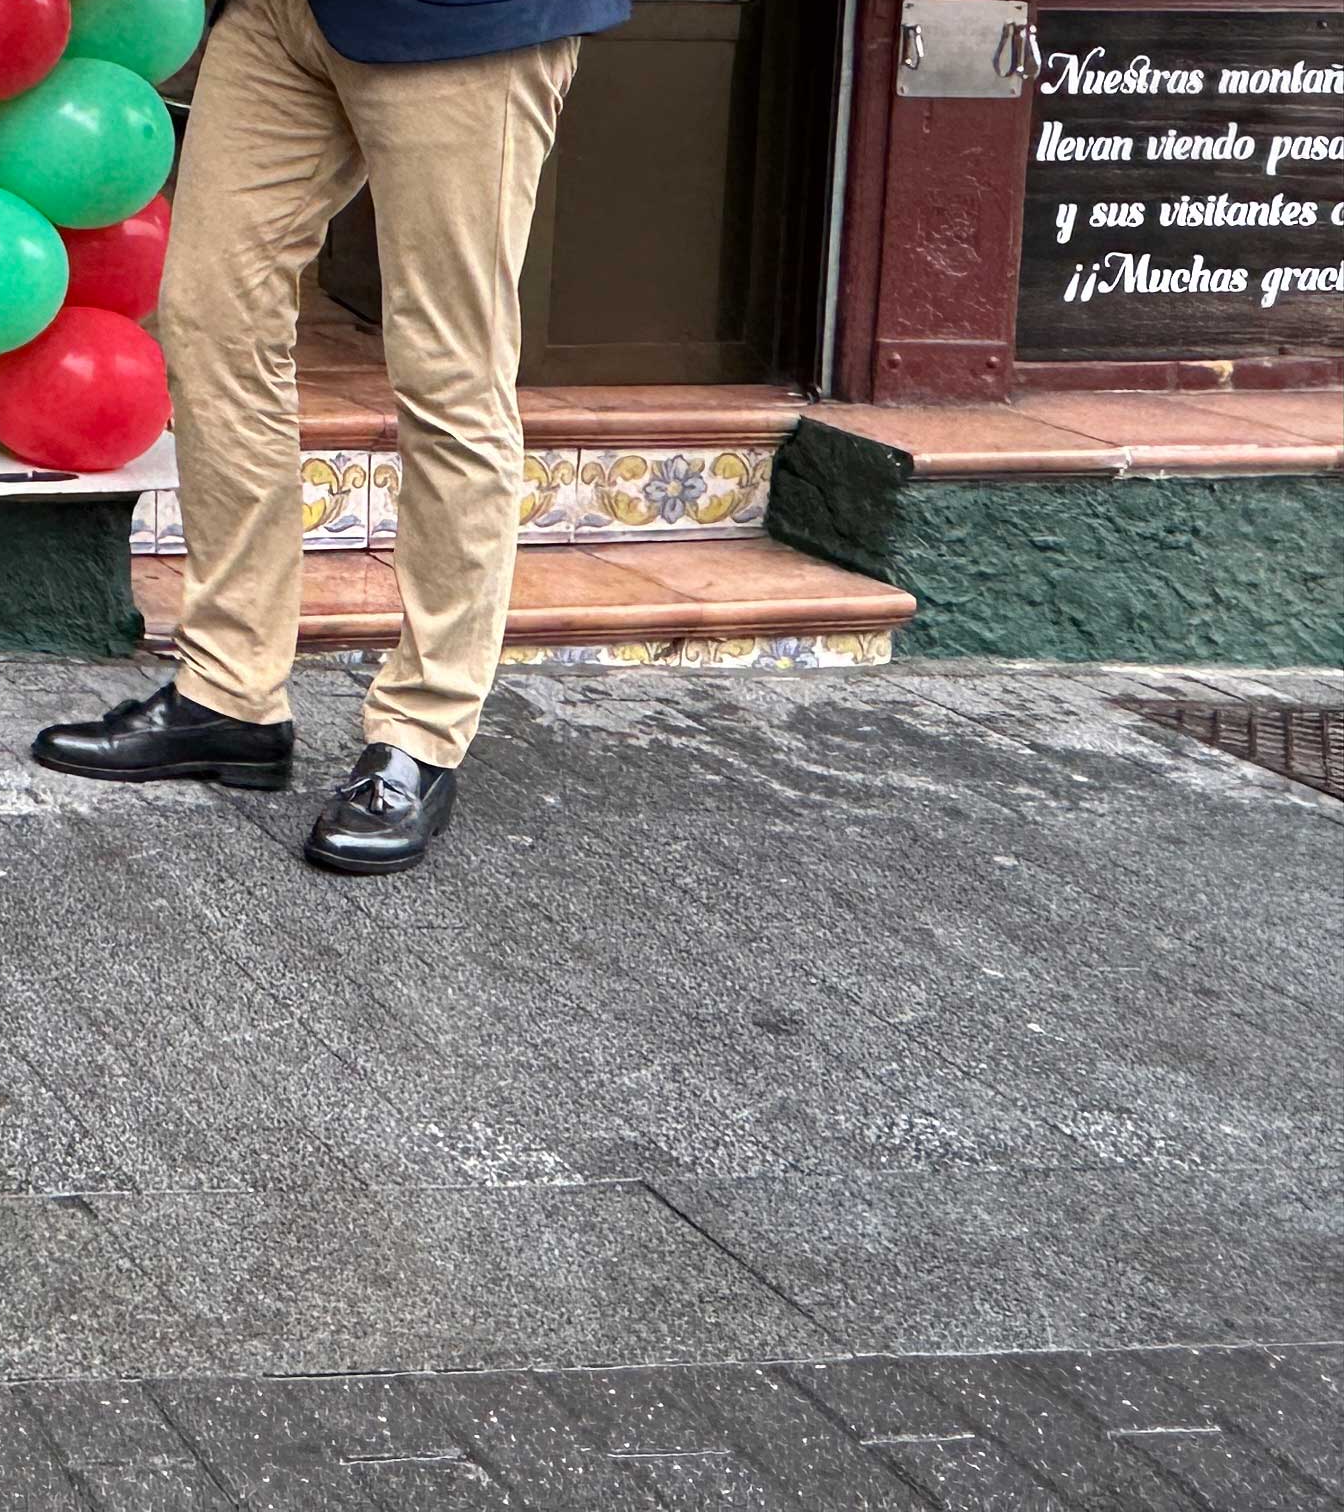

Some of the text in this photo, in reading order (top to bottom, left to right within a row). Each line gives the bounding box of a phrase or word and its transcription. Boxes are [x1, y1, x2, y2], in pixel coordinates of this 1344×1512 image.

[1040, 47, 1204, 94] Nuestras
[1036, 122, 1133, 161] llevan
[1146, 122, 1255, 161] viendo
[1055, 203, 1078, 244] y
[1089, 202, 1146, 227] sus
[1159, 193, 1318, 227] visitantes
